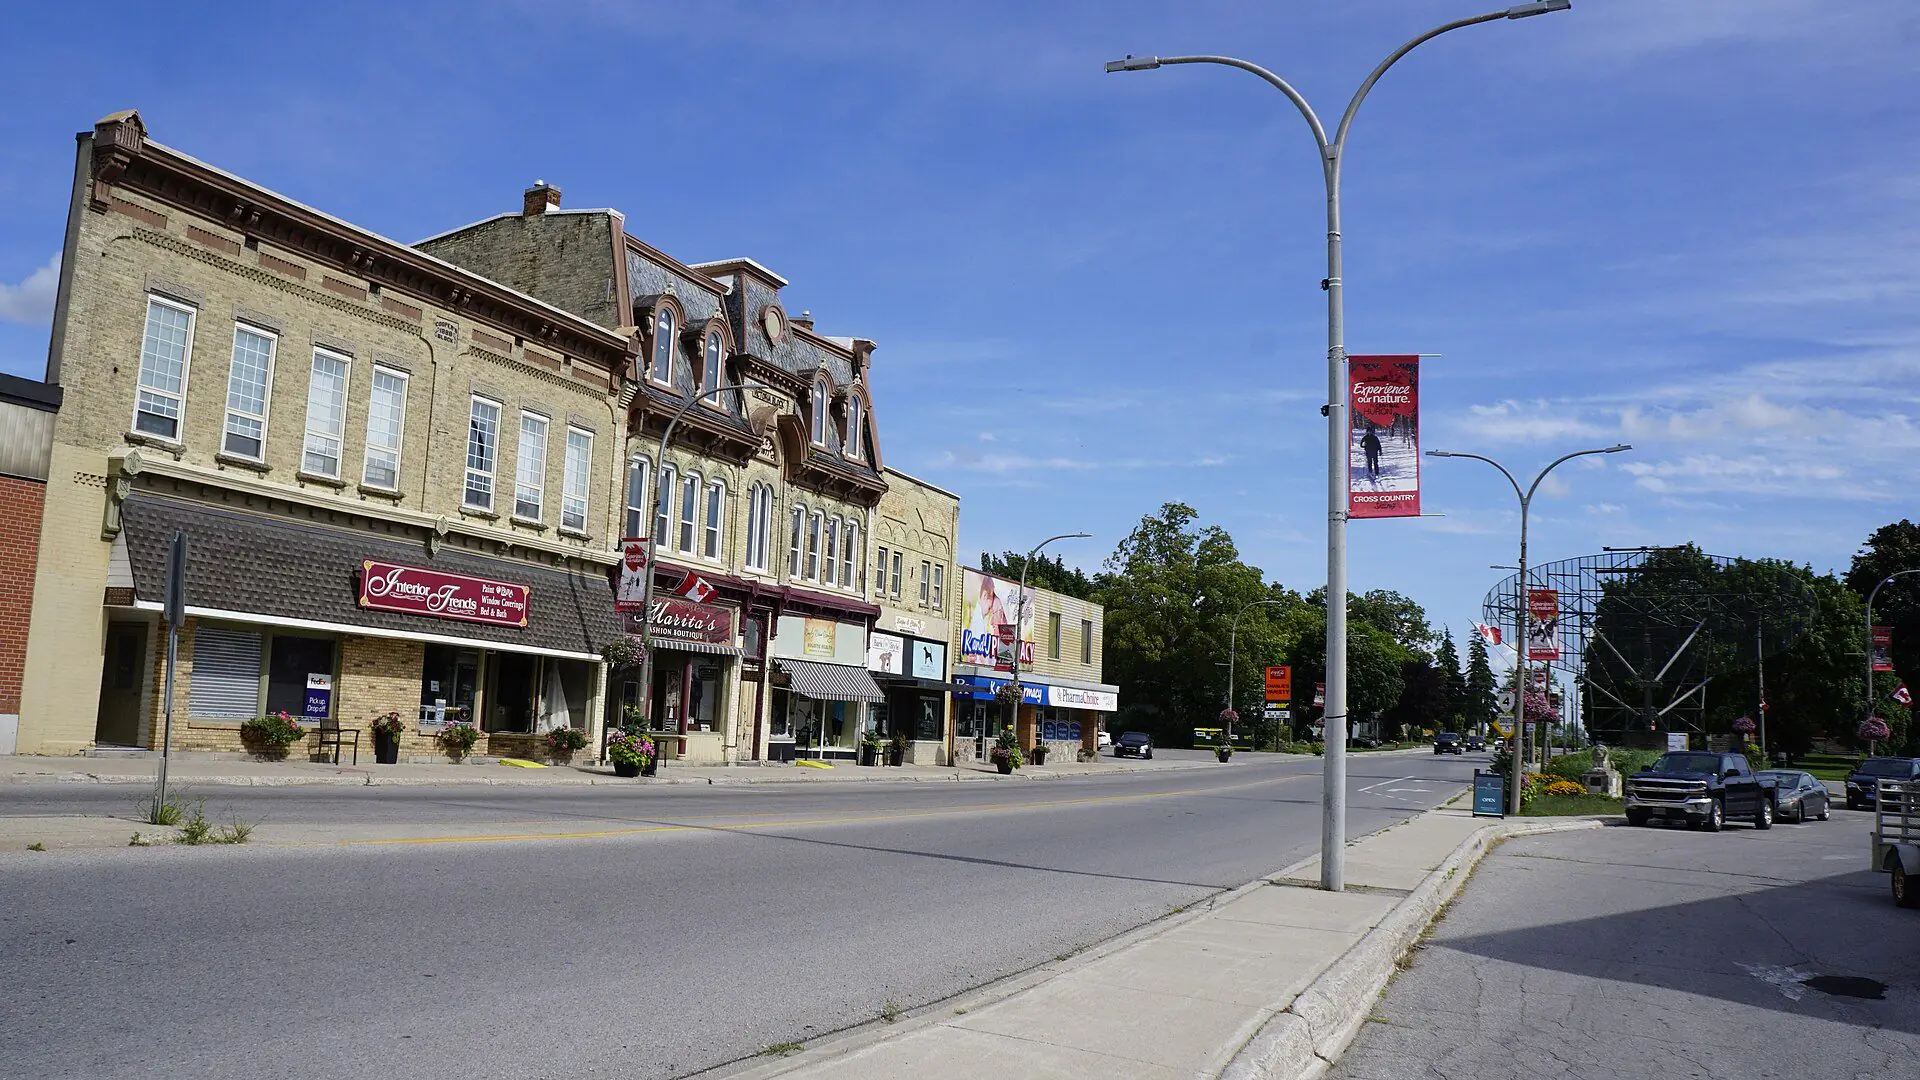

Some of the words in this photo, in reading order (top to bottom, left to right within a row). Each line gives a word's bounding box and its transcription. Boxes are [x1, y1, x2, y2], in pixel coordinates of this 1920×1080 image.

[1353, 382, 1410, 397] Experience
[1357, 396, 1373, 404] our
[1373, 394, 1411, 404] nature.
[1353, 495, 1379, 503] CROSS
[1379, 494, 1416, 502] COUNTRY
[368, 568, 431, 597] Interior
[482, 584, 495, 594] Paint
[427, 585, 477, 612] Trends
[482, 595, 500, 606] Window
[501, 598, 524, 611] Coverings
[480, 607, 490, 616] Bed
[490, 608, 496, 617] &
[496, 609, 508, 618] Bath
[673, 629, 703, 640] BOUTIQUE
[310, 677, 326, 686] FedEx
[310, 697, 319, 705] Pick
[1063, 689, 1099, 706] PharmaChoice
[1502, 697, 1510, 706] 4
[306, 704, 319, 713] Drop
